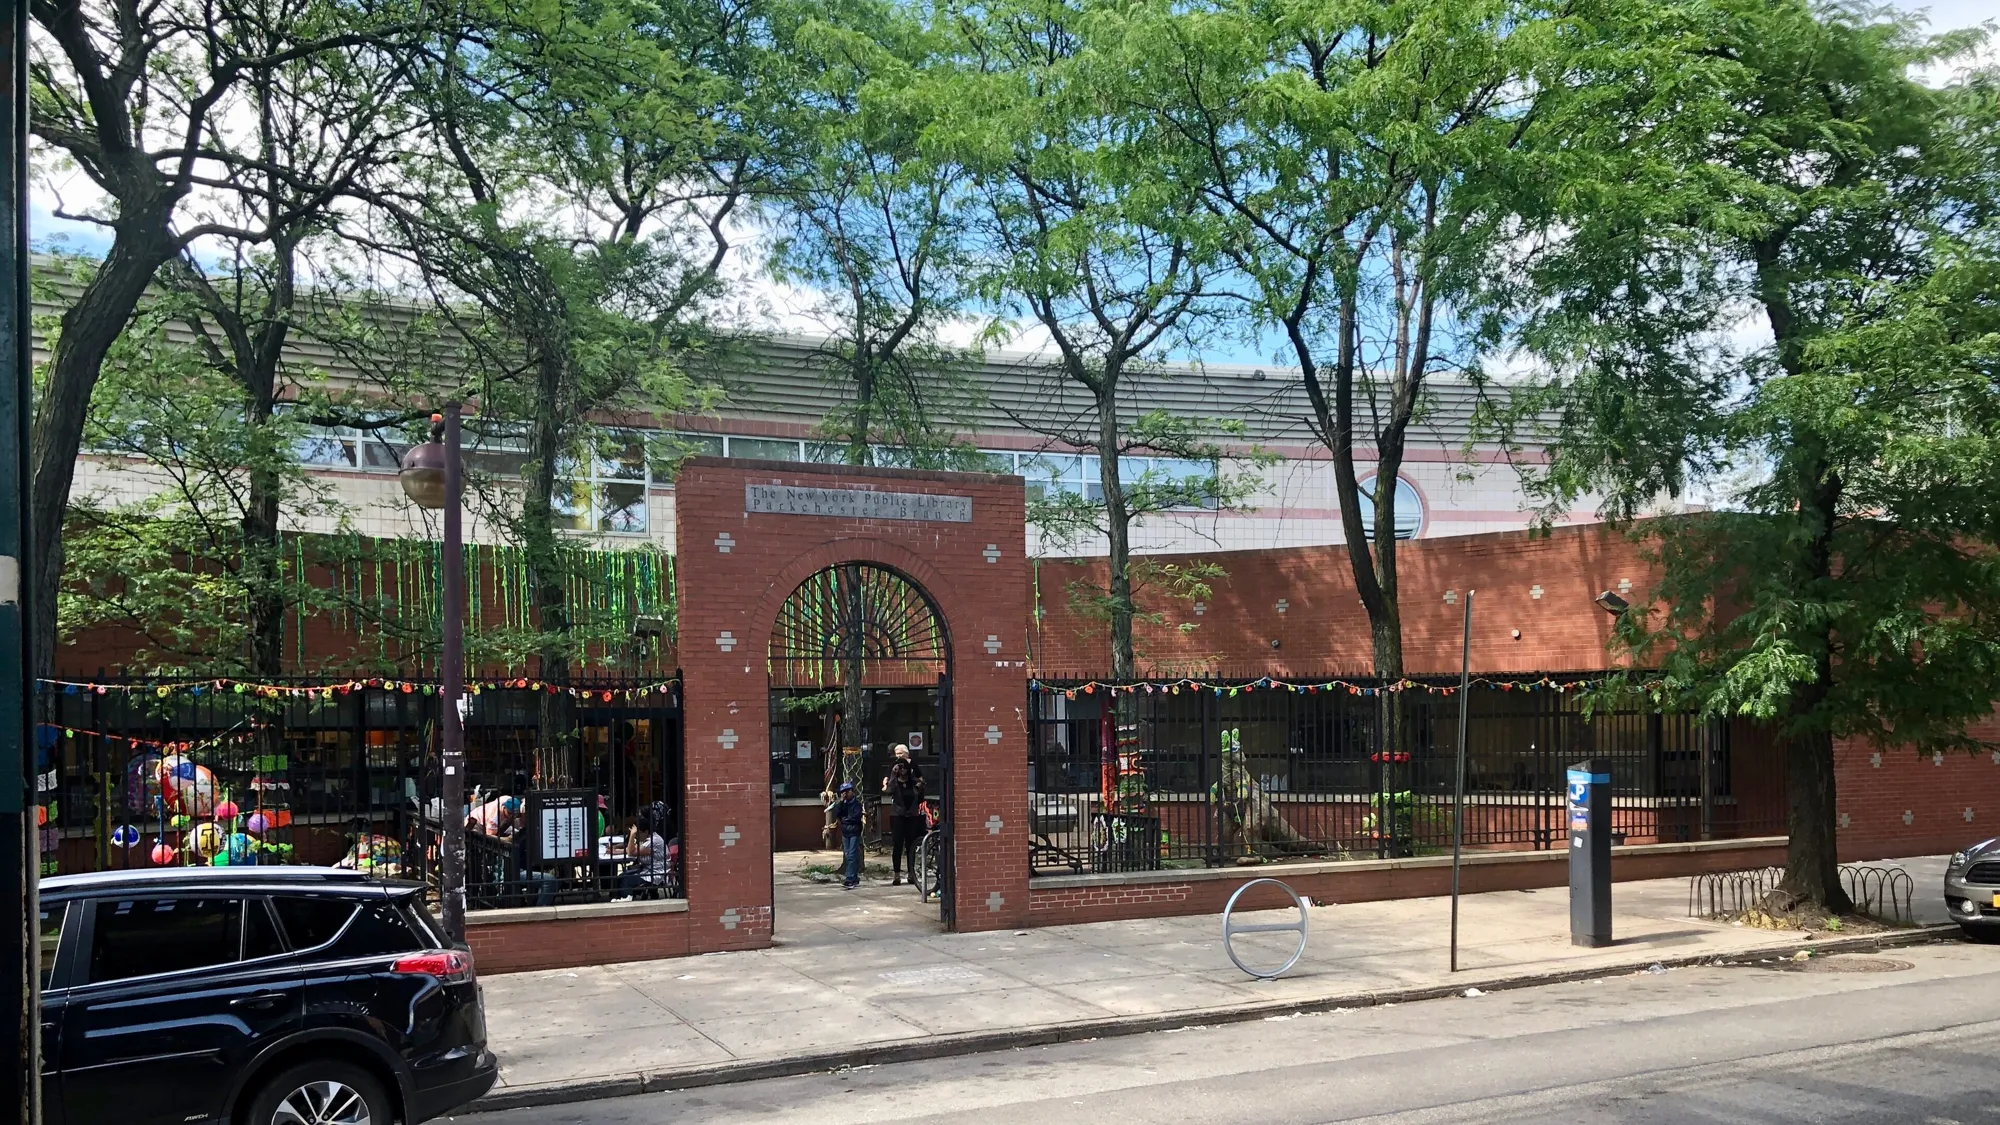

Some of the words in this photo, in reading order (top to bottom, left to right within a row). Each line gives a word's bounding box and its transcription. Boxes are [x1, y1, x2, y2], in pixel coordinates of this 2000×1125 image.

[751, 486, 776, 499] The
[787, 489, 815, 500] New
[822, 491, 855, 503] York
[864, 493, 908, 506] Public
[918, 496, 968, 511] Library
[753, 499, 881, 516] Parkchester
[900, 506, 966, 520] Branch
